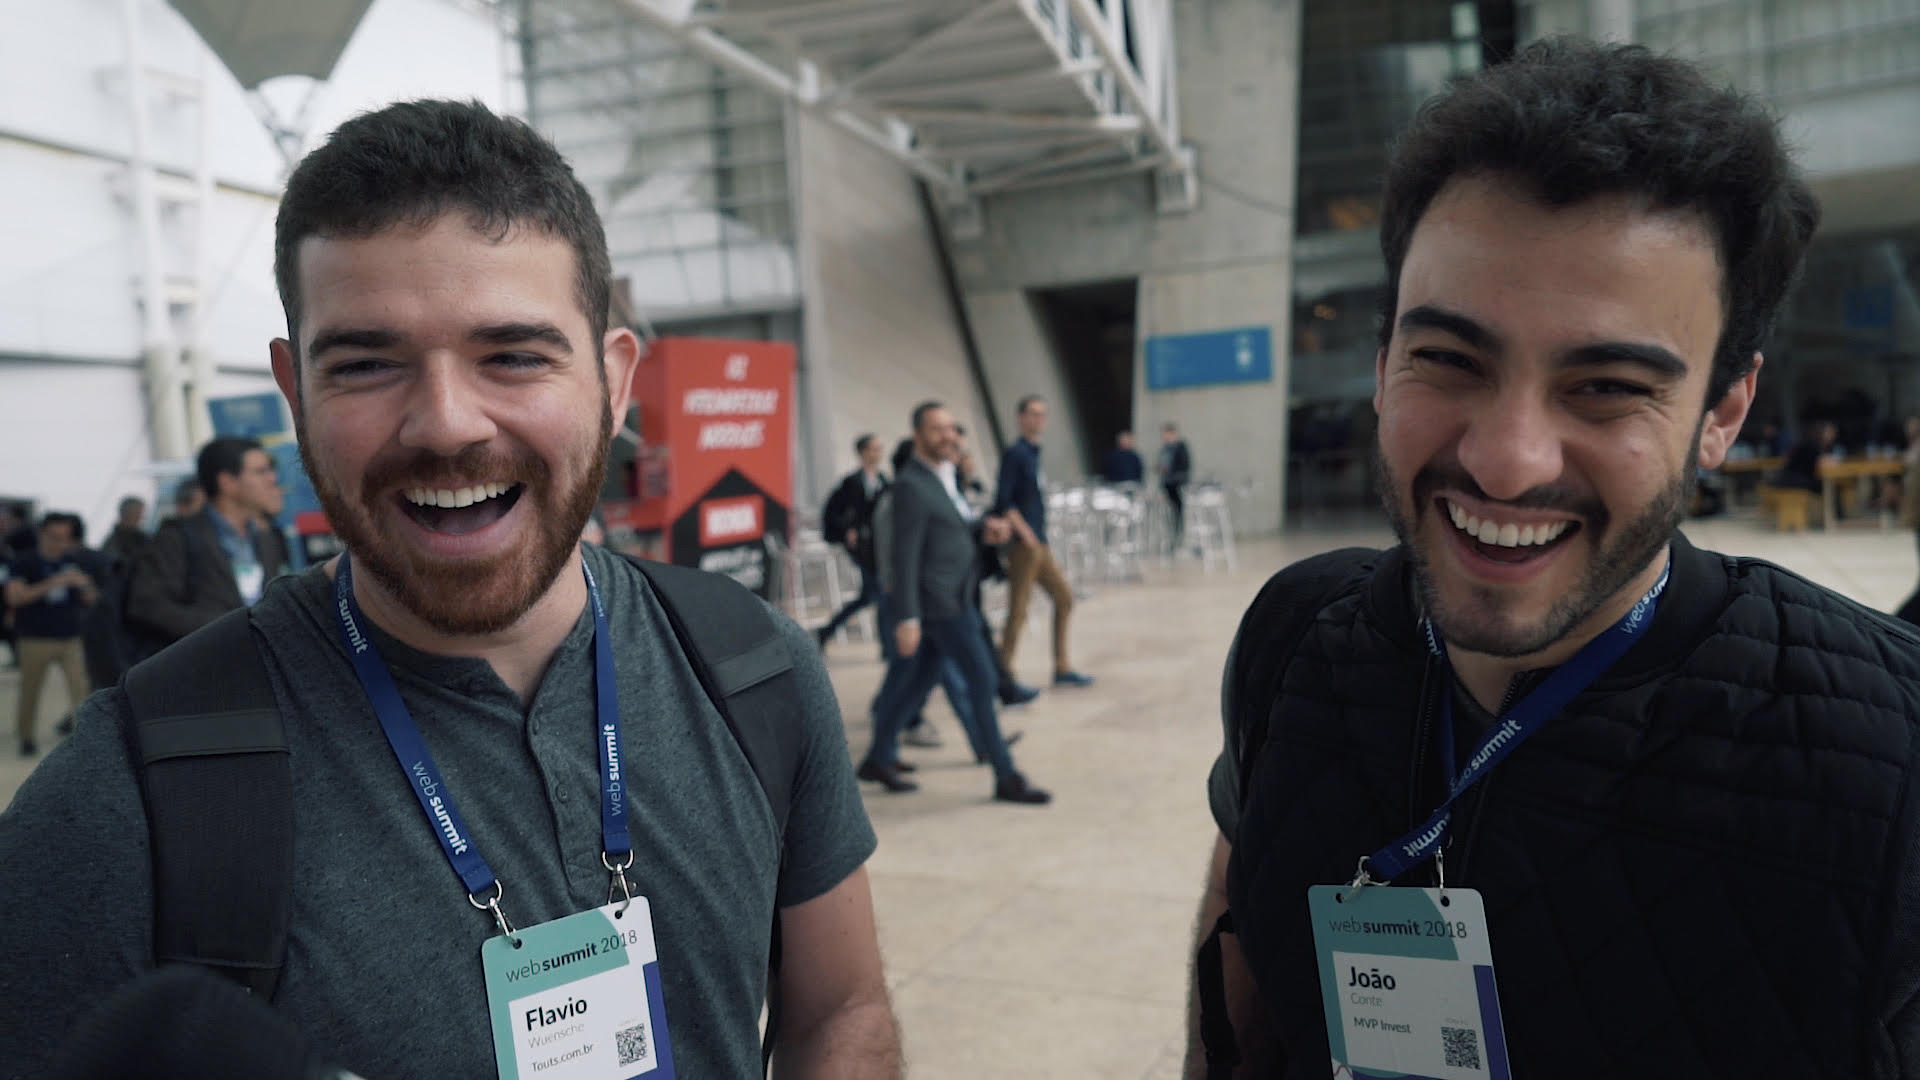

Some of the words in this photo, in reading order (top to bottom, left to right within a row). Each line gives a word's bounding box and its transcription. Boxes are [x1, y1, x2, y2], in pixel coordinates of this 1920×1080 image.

[600, 929, 638, 954] 2018
[1424, 920, 1468, 939] 2018
[1348, 966, 1397, 991] João
[1350, 992, 1383, 1008] Conte
[525, 996, 588, 1032] Flavio
[1353, 1016, 1379, 1029] MVP
[1380, 1019, 1412, 1034] Invest
[527, 1022, 586, 1049] Wuensche
[531, 1042, 595, 1073] Touts.com.br
